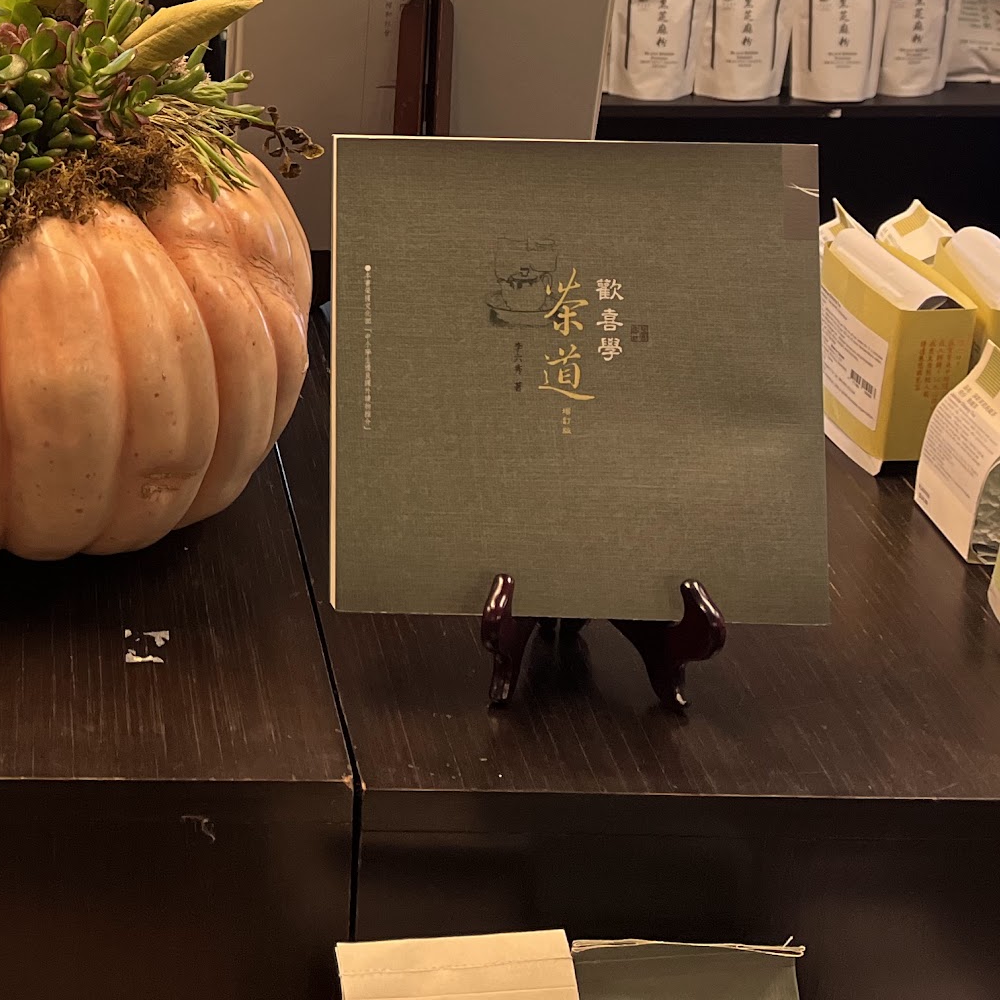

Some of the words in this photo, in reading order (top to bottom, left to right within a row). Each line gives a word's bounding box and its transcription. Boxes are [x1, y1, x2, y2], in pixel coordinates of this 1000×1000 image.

[538, 267, 595, 400] 茶道
[596, 278, 624, 361] 歡喜學
